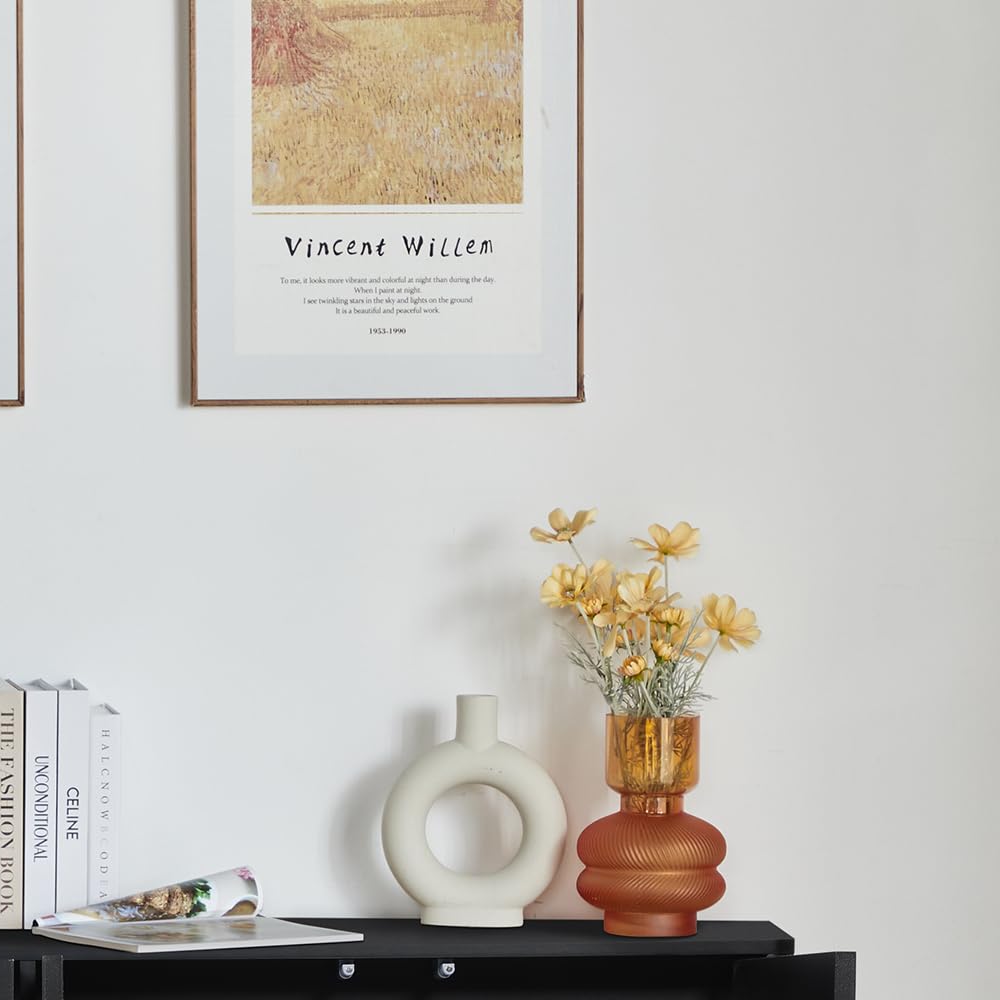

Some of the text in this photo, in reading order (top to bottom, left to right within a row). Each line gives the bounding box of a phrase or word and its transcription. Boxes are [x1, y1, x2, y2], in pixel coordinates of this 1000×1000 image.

[284, 235, 494, 258] Vincent Willem
[449, 276, 470, 284] during
[318, 297, 348, 305] twinkling
[385, 297, 395, 305] sky
[410, 297, 427, 305] lights
[0, 708, 14, 914] THE FASHION BOOK
[33, 756, 49, 862] UNCONDITIONAL
[66, 786, 80, 840] CELINE
